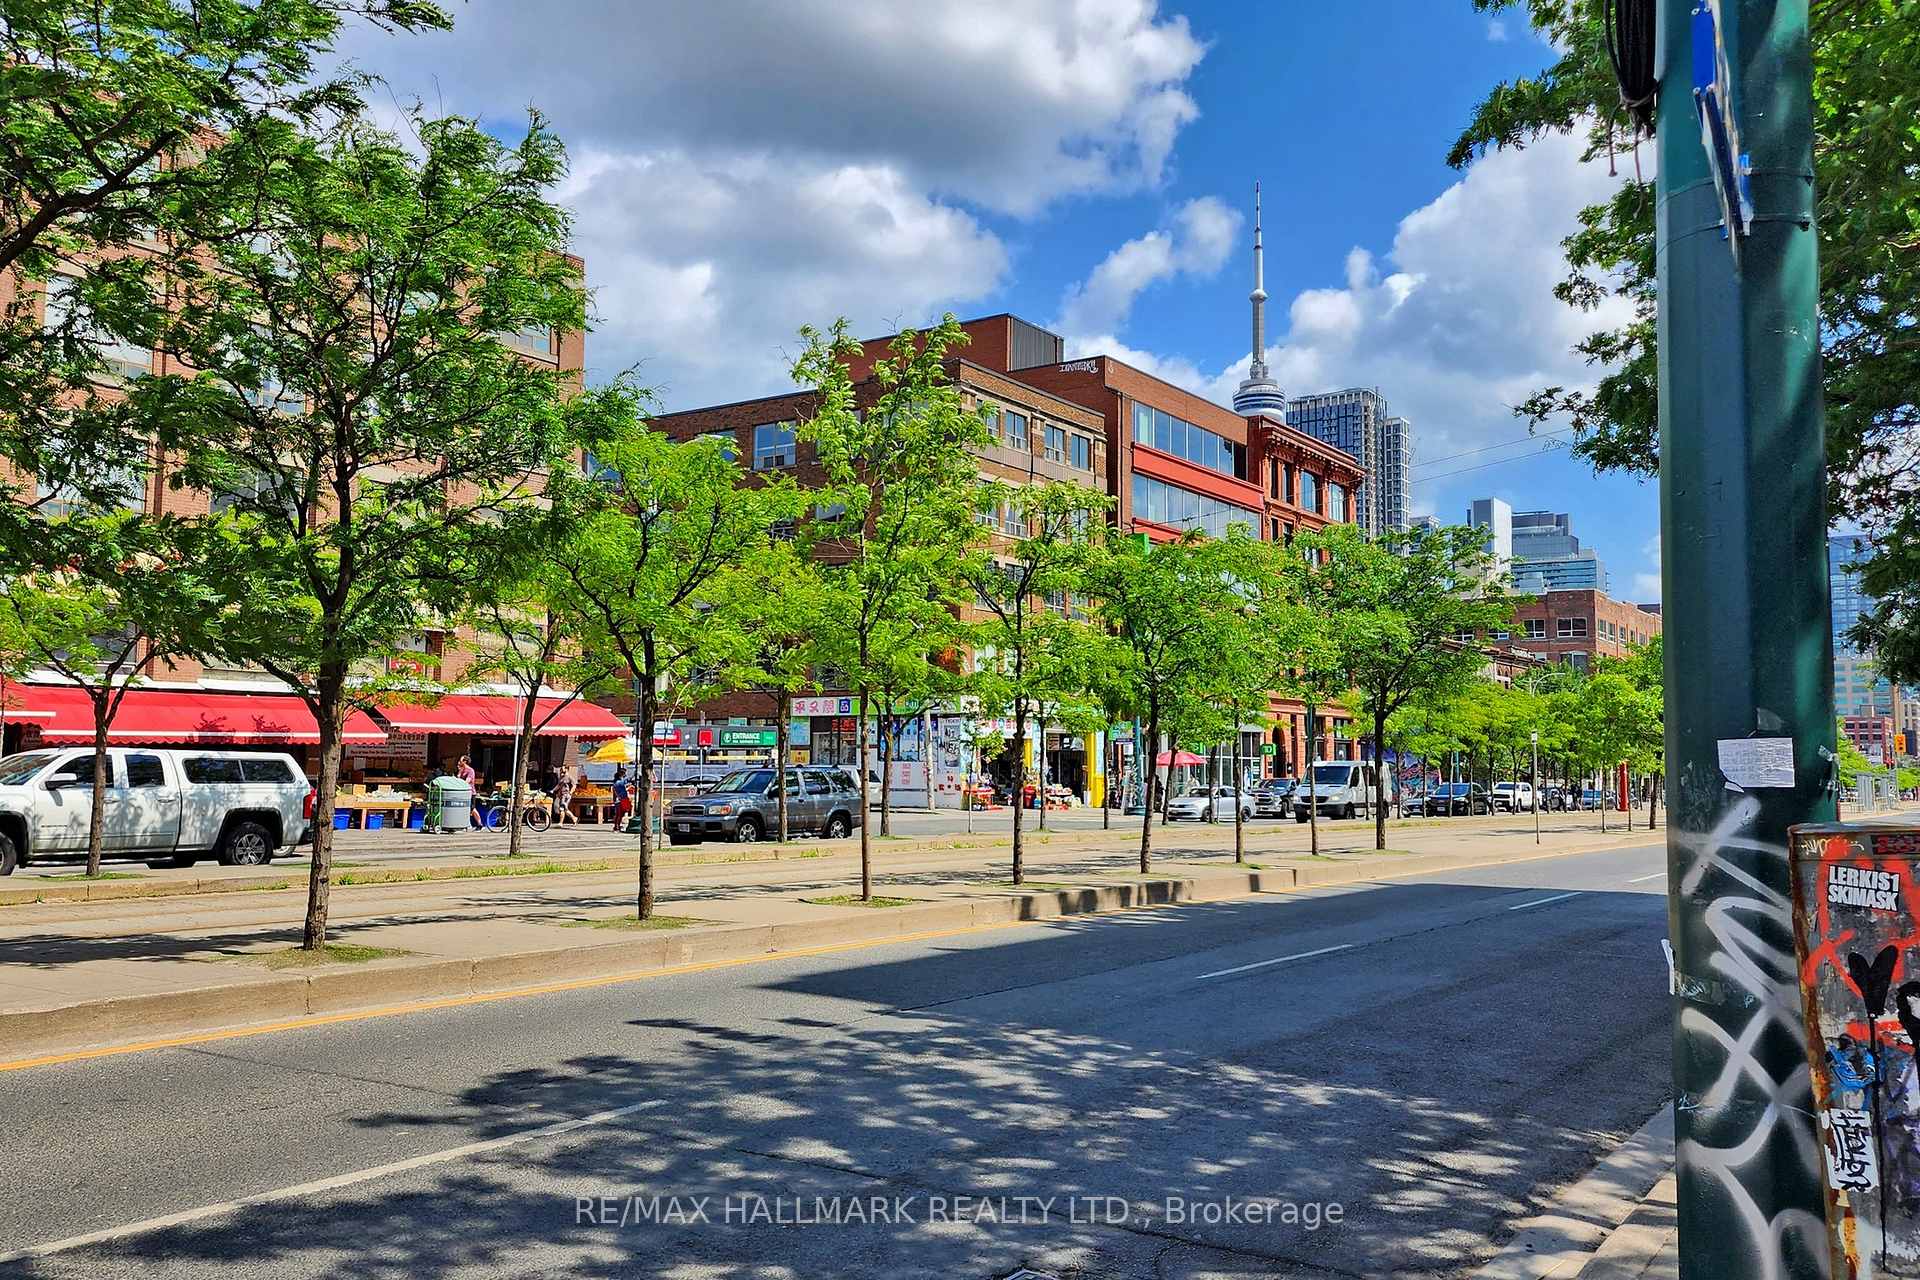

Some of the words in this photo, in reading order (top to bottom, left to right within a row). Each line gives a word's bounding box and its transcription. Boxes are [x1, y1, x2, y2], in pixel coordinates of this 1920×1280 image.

[732, 732, 760, 740] ENTRANCE
[1829, 865, 1900, 892] LERKIS1
[1828, 884, 1899, 911] SKIMASK
